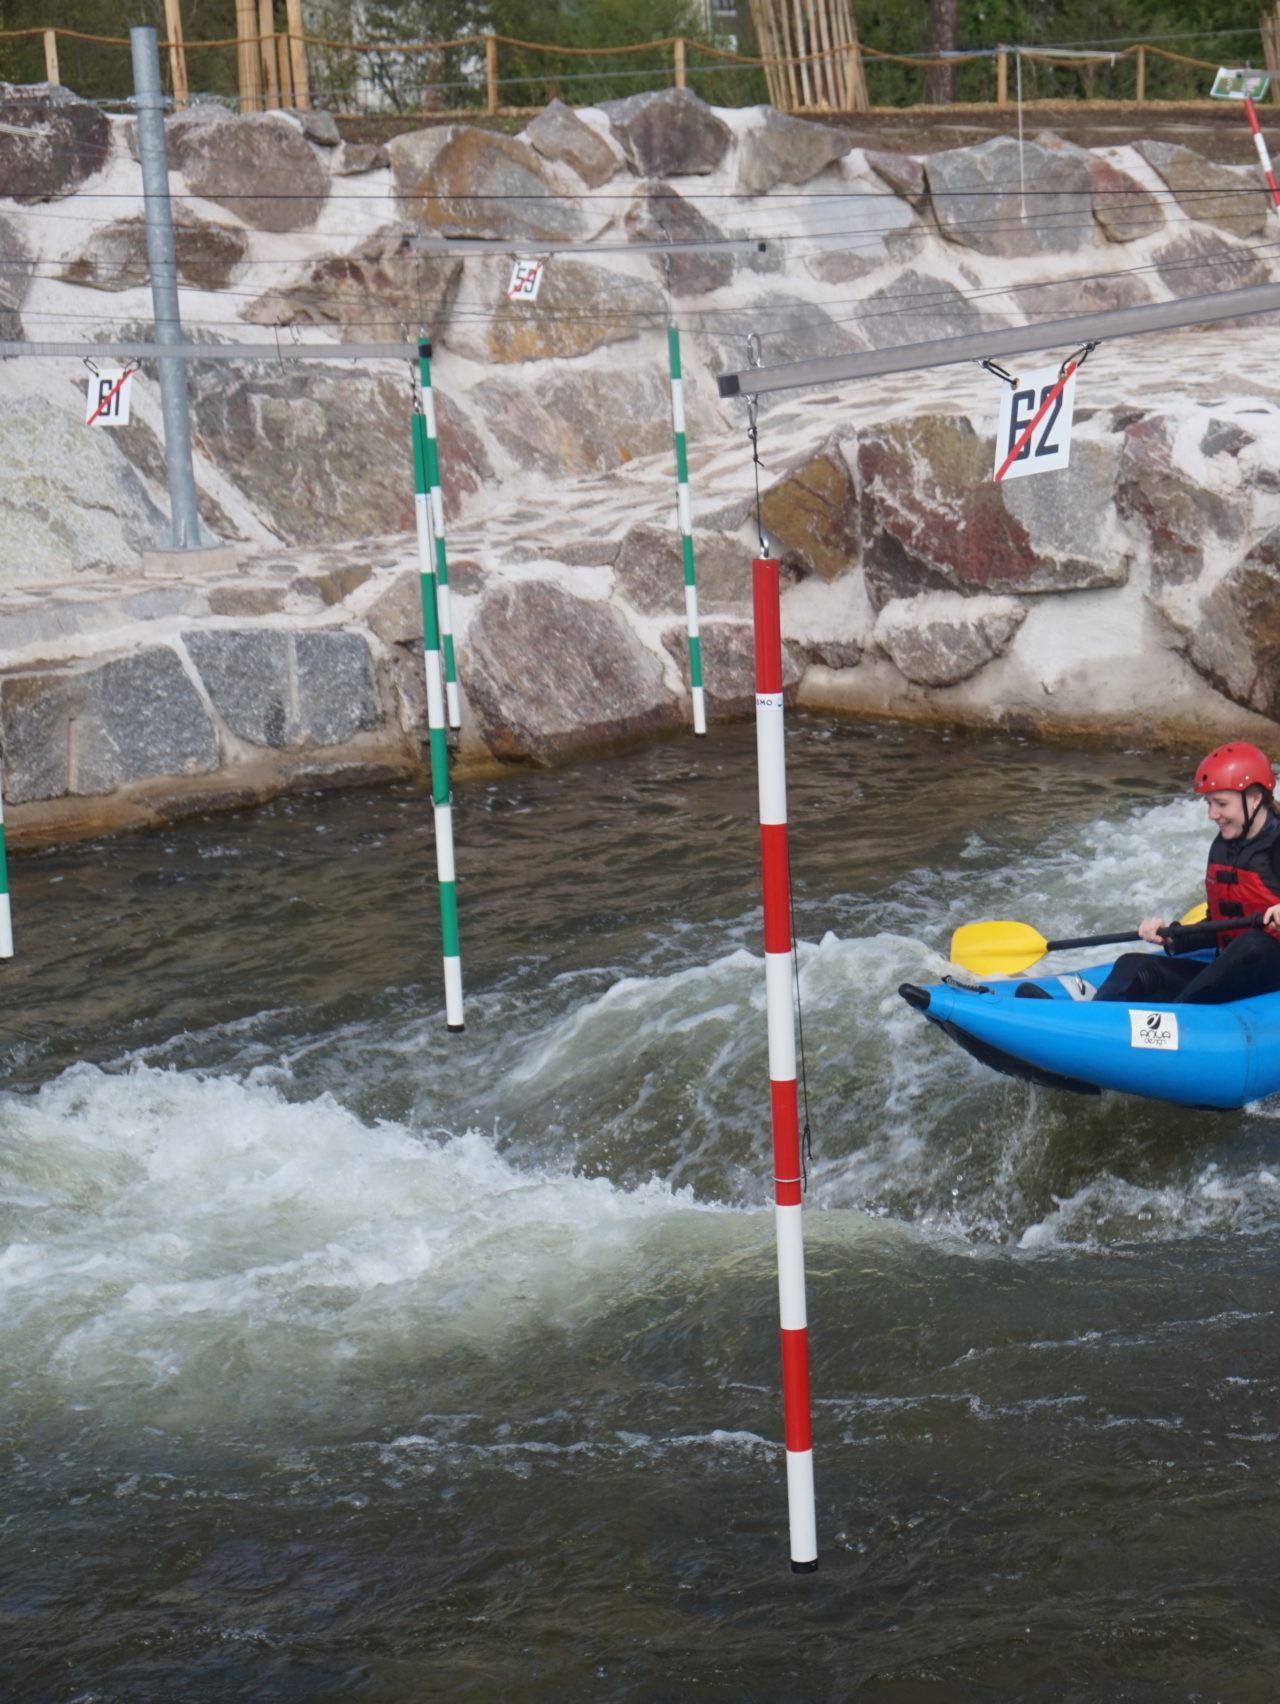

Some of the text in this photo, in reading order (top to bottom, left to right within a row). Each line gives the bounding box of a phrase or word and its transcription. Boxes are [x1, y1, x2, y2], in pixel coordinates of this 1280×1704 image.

[513, 268, 537, 293] 59
[97, 379, 121, 416] 61
[1008, 384, 1064, 462] 62
